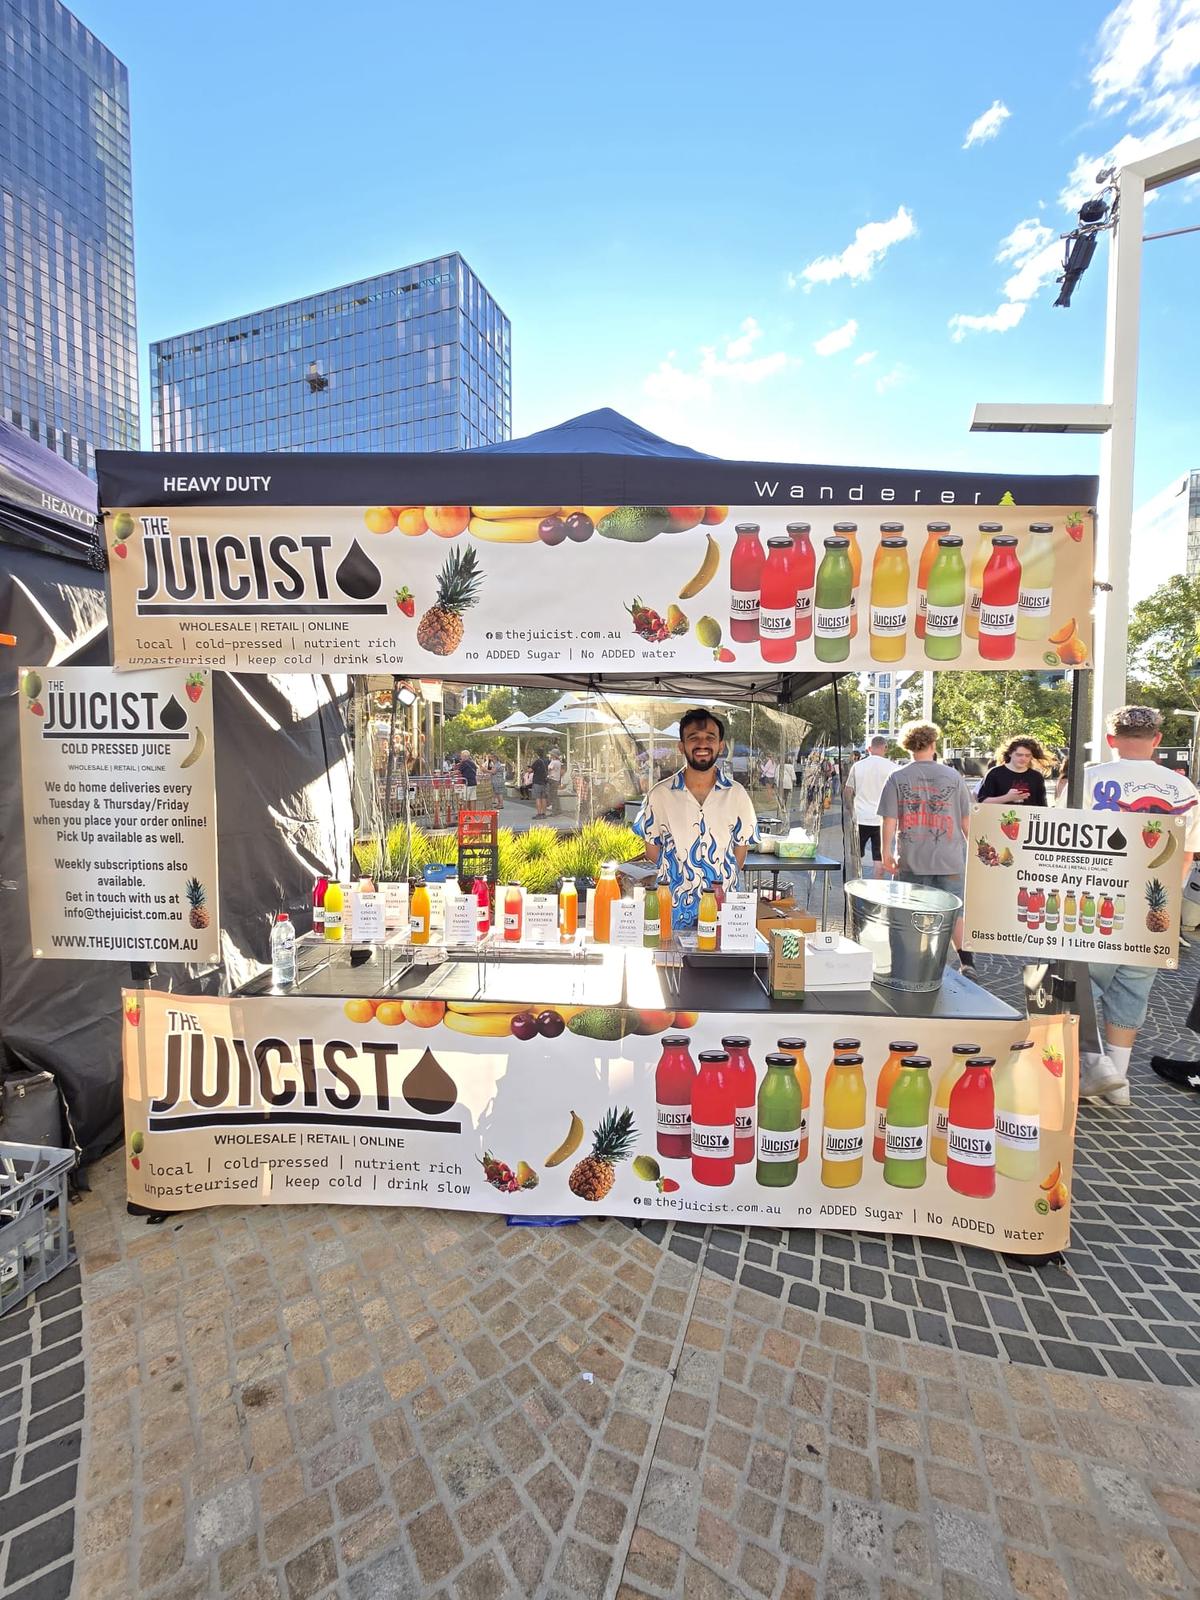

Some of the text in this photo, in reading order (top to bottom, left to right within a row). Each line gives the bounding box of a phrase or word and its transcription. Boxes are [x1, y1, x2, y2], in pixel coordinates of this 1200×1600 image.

[163, 476, 271, 492] HEAVY DUTY
[754, 481, 981, 504] Wanderer
[41, 494, 85, 522] HEAVY
[140, 518, 169, 535] THE
[137, 535, 332, 601] JUICIST
[179, 622, 252, 632] WHOLESALE
[260, 622, 299, 632] RETAIL
[308, 622, 349, 632] ONLINE
[505, 629, 621, 642] thejuicist.com.au
[136, 638, 172, 649] local
[195, 638, 282, 651] cold-pressed
[304, 638, 360, 649] nutrient
[367, 637, 396, 648] rich
[128, 655, 226, 666] unpasteurised
[248, 654, 280, 666] keep
[284, 654, 312, 665] cold
[333, 653, 370, 664] drink
[375, 653, 403, 665] slow
[465, 652, 479, 660] no
[486, 649, 520, 660] ADDED
[527, 649, 561, 662] Sugar
[581, 649, 594, 659] No
[601, 649, 635, 659] ADDED
[642, 650, 676, 659] water
[48, 681, 64, 691] THE
[43, 692, 159, 731] JUICIST
[61, 743, 171, 755] COLD PRESSED JUICE
[45, 781, 192, 796] We do home deliveries every
[49, 798, 189, 812] Tuesday & Thursday/Friday
[33, 815, 207, 829] when you place your order online!
[1029, 813, 1041, 821] THE
[57, 831, 184, 844] Pick Up available as well.
[1023, 821, 1108, 849] JUICIST
[55, 858, 188, 873] Weekly subscriptions also
[1034, 853, 1113, 866] COLD PRESSED JUICE
[97, 876, 146, 887] available.
[1016, 870, 1129, 888] Choose Any Flavour
[65, 891, 180, 904] Get in touch with us at
[64, 907, 182, 921] info@thejuicist.com.au
[52, 935, 198, 951] WWW.THEJUICIST.COM.AU
[971, 930, 995, 941] Glass
[997, 932, 1044, 946] bottle/Cup
[1046, 936, 1057, 946] $9
[1068, 938, 1073, 947] 1
[1075, 938, 1095, 950] Litre
[1098, 940, 1122, 952] Glass
[1124, 943, 1151, 954] bottle
[1153, 945, 1170, 955] $20
[168, 1011, 201, 1032] THE
[151, 1033, 399, 1112] JUICIST
[657, 1113, 687, 1124] JUICIST
[995, 1117, 1032, 1138] JUICIST
[214, 1134, 296, 1145] WHOLESALE
[307, 1133, 350, 1145] RETAIL
[360, 1136, 405, 1148] ONLINE
[761, 1137, 796, 1150] JUICIST
[827, 1137, 859, 1150] JUICIST
[950, 1135, 985, 1151] JUICIST
[149, 1162, 193, 1177] local
[224, 1157, 329, 1170] cold-pressed
[354, 1158, 420, 1172] nutrient
[429, 1161, 462, 1175] rich
[144, 1177, 258, 1197] unpasteurised
[285, 1175, 320, 1190] keep
[329, 1175, 362, 1187] cold
[387, 1179, 428, 1193] drink
[437, 1182, 471, 1195] slow
[656, 1198, 782, 1215] thejuicist.com.au
[798, 1207, 812, 1215] no
[820, 1205, 857, 1216] ADDED
[865, 1207, 903, 1221] Sugar
[927, 1213, 943, 1225] No
[952, 1216, 995, 1235] ADDED
[1004, 1228, 1045, 1241] water
